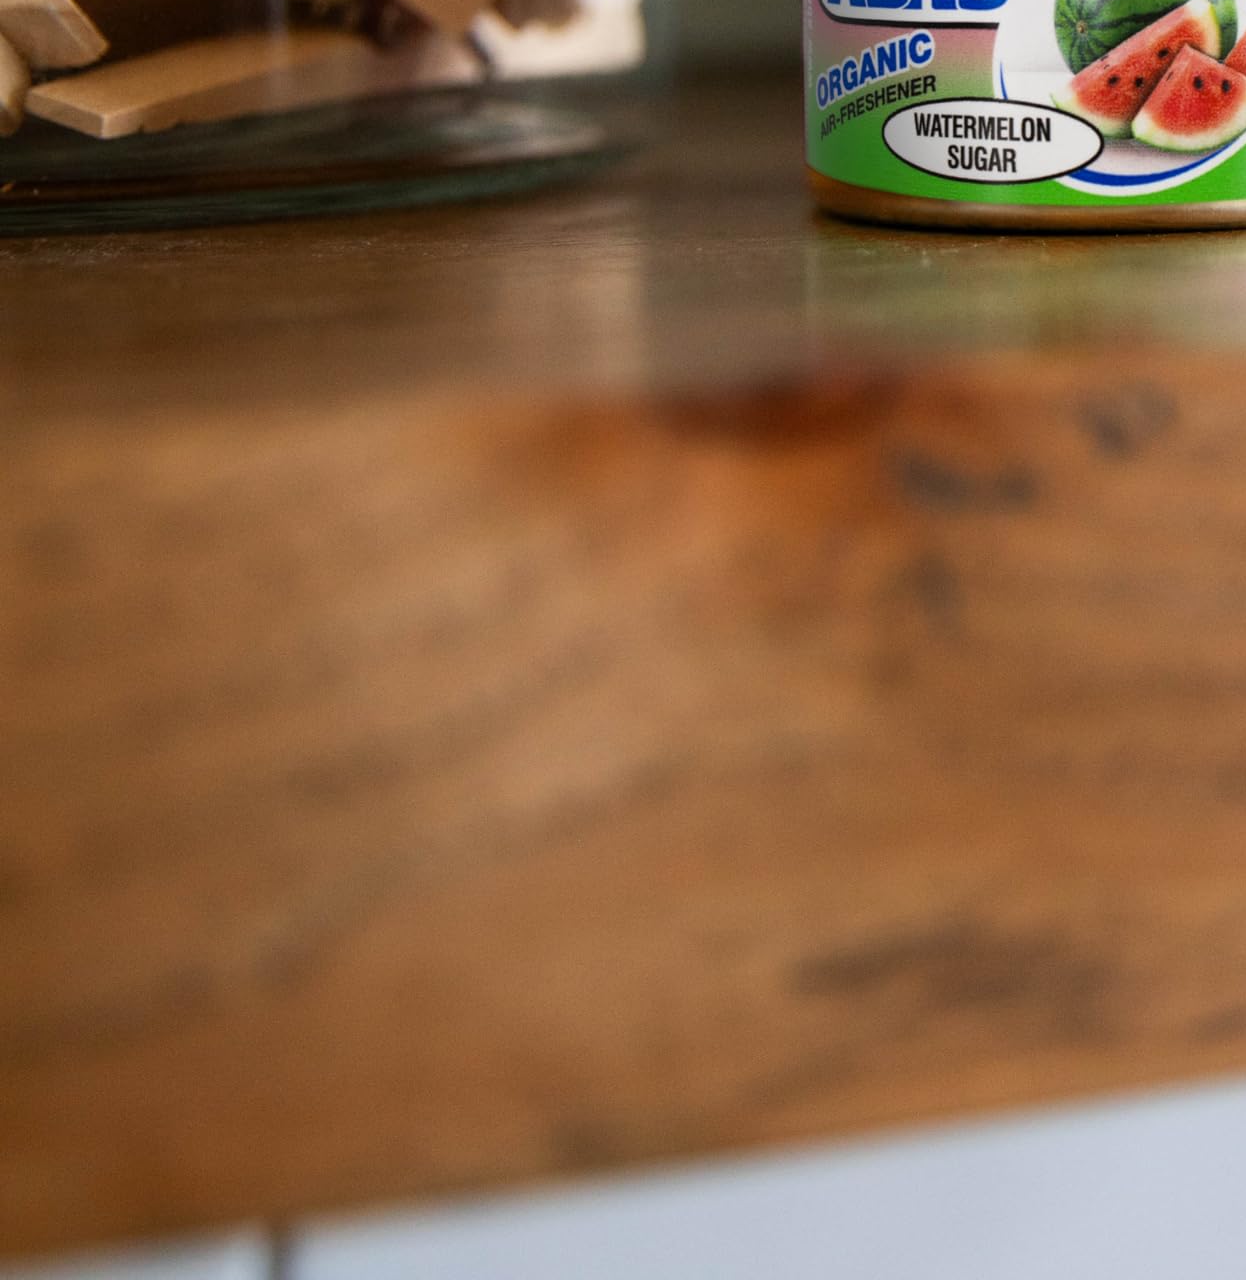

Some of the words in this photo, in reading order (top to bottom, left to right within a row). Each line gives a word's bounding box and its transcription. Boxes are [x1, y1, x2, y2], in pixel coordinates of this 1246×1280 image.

[816, 32, 933, 107] ORGANIC
[820, 74, 936, 140] AIR-FRESHENER
[913, 112, 1052, 142] WATERMELON
[947, 145, 1017, 173] SUGAR
